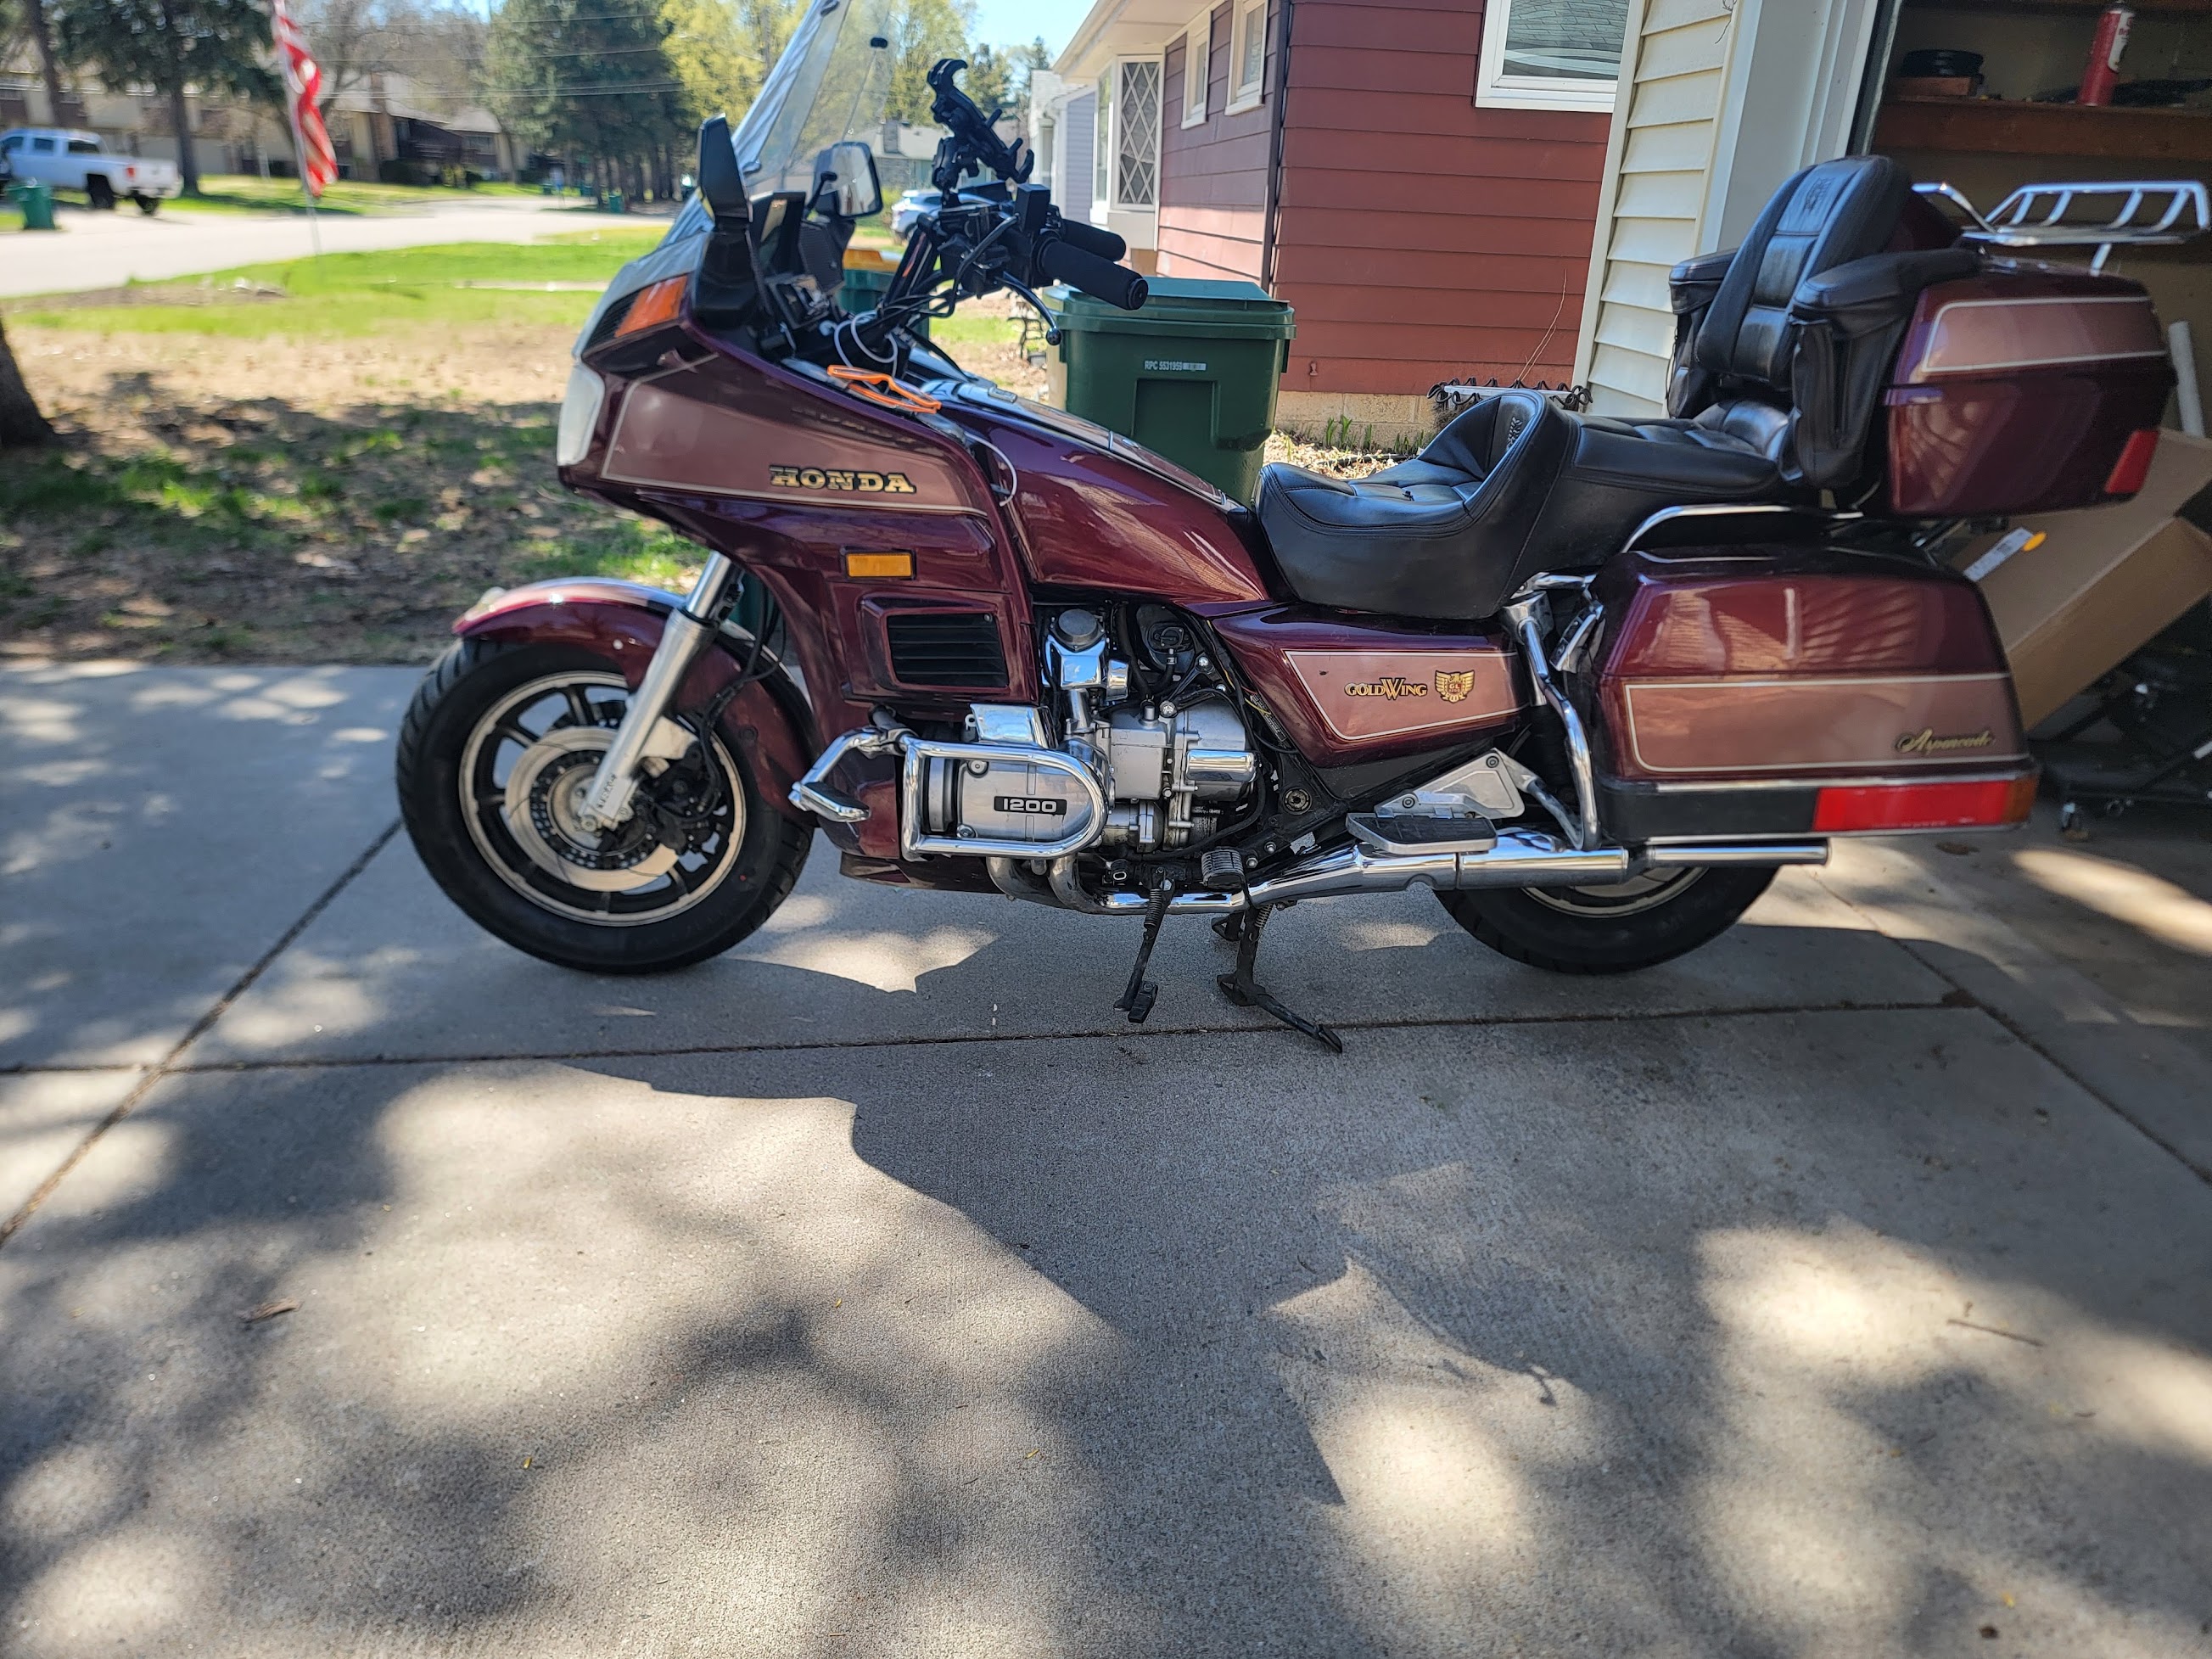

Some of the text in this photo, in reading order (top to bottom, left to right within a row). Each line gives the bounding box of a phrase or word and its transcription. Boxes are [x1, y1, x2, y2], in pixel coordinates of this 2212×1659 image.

[1144, 360, 1158, 371] RPC
[770, 466, 916, 493] HONDA
[1003, 798, 1057, 813] 1200
